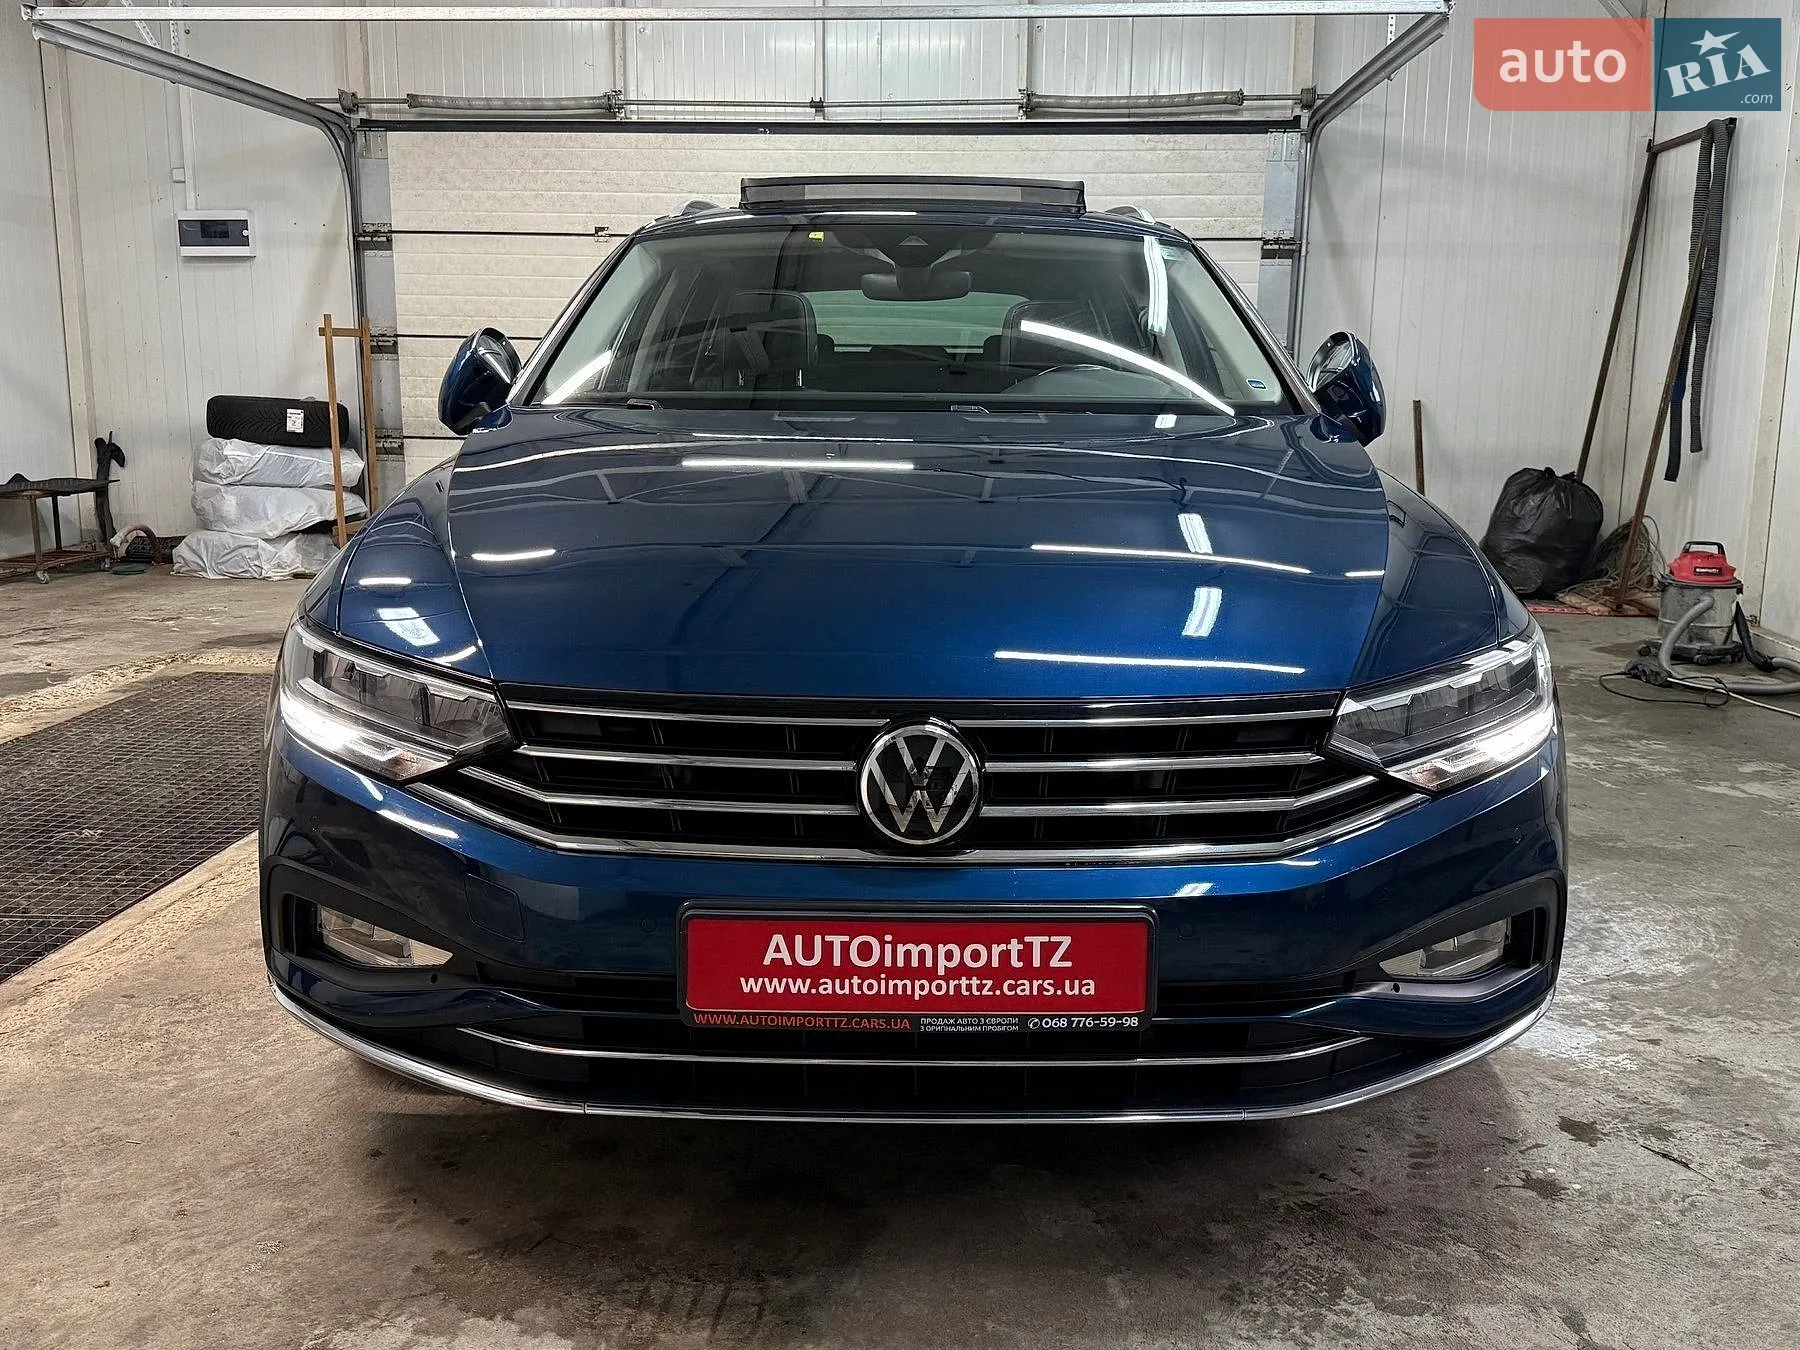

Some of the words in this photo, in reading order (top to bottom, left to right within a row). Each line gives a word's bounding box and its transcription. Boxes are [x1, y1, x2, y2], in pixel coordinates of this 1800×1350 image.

[762, 933, 1074, 975] AUTOimportTZ
[739, 974, 1096, 1000] www.autoimporttz.cars.ua
[693, 1013, 911, 1029] WWW.AUTOIMPORTTZ.CARS.UA
[1042, 1018, 1068, 1028] 068
[1071, 1017, 1139, 1028] 776-59-98
